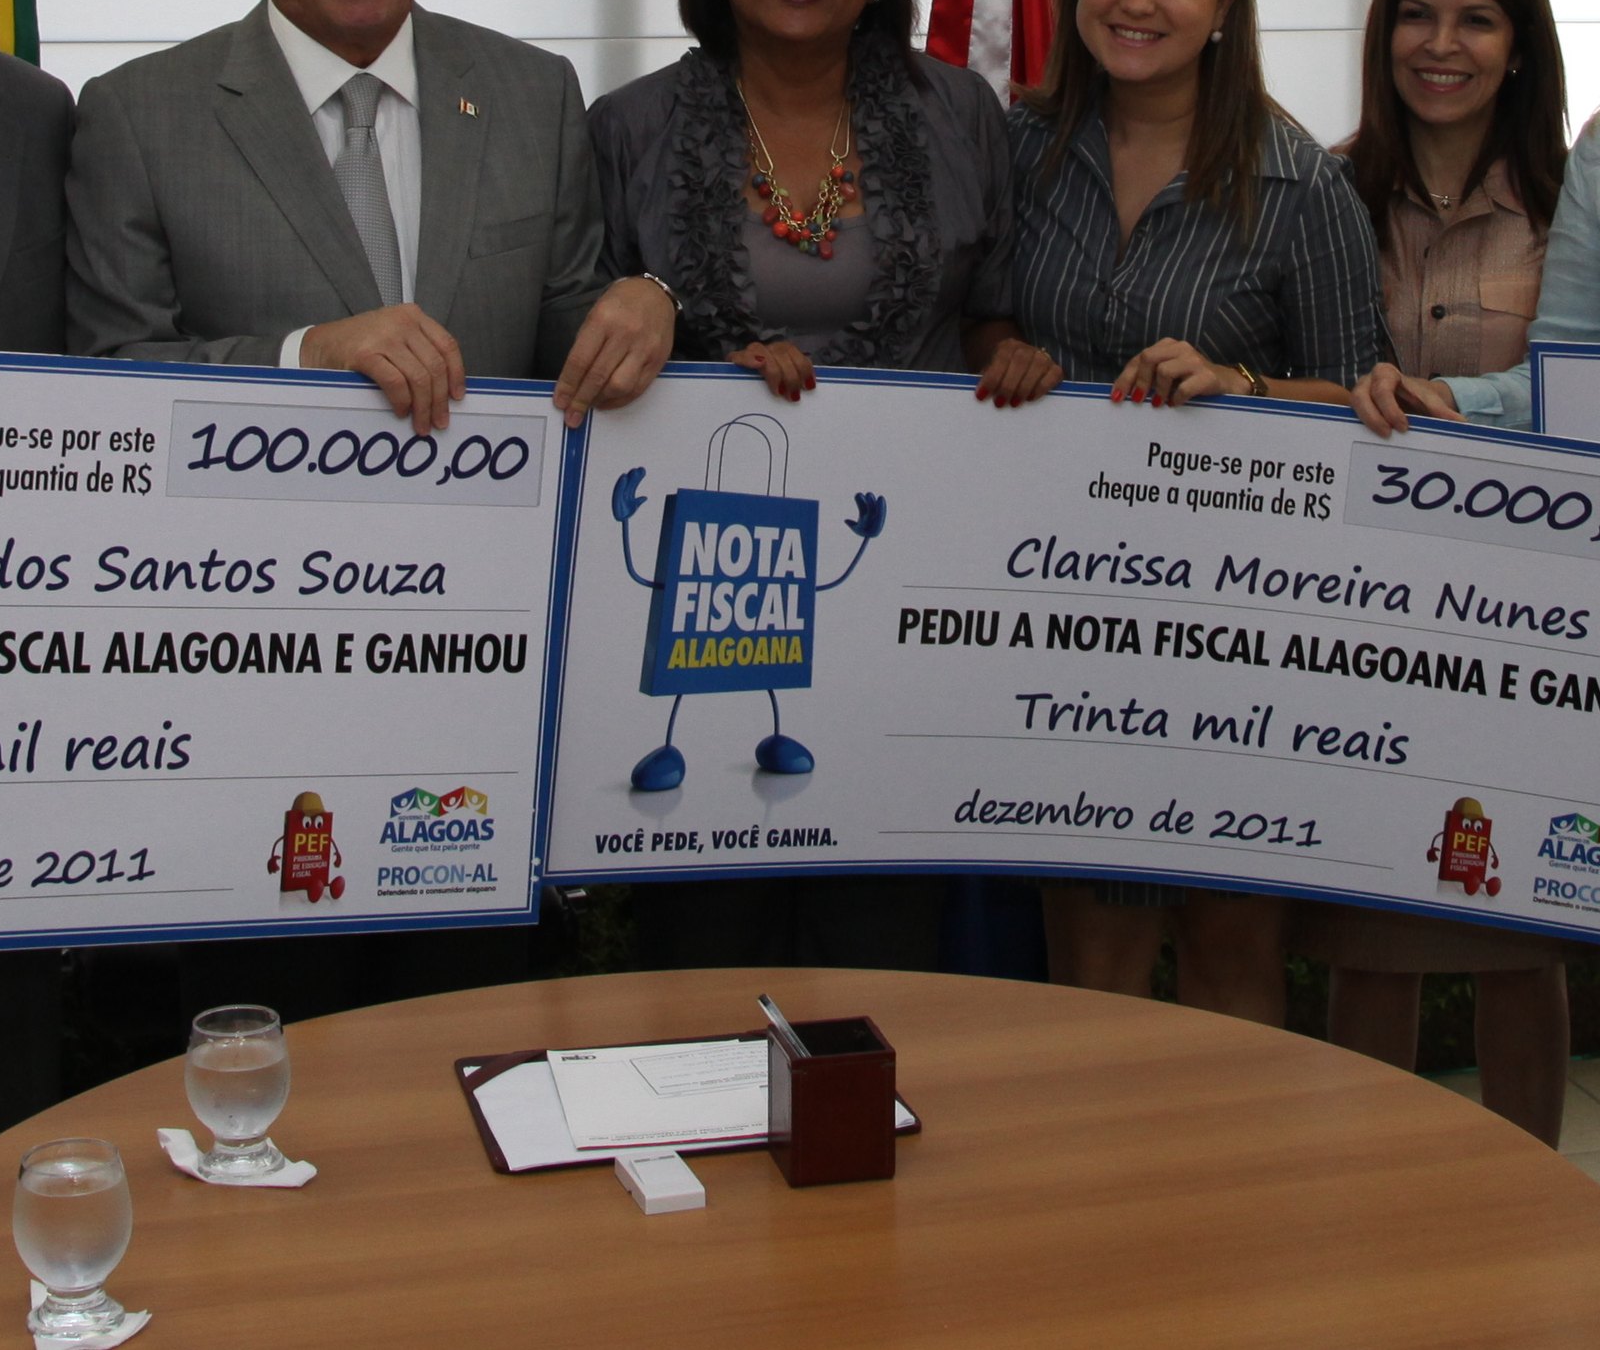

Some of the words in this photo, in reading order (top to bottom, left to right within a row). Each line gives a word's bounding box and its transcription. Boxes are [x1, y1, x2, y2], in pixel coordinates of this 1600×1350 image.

[61, 429, 102, 458] por
[109, 427, 155, 453] este
[187, 418, 530, 486] 100.000,00
[1147, 441, 1243, 477] Pague-se
[1249, 459, 1286, 483] por
[1292, 461, 1335, 485] este
[86, 460, 114, 493] de
[122, 462, 152, 496] R$
[1088, 471, 1160, 508] cheque
[1166, 486, 1180, 505] a
[1186, 487, 1262, 513] quantia
[1270, 487, 1296, 516] de
[1303, 492, 1332, 521] R$
[94, 545, 277, 594] Santos
[298, 550, 446, 597] Souza
[679, 522, 806, 579] NOTA
[672, 581, 804, 633] FISCAL
[1006, 535, 1192, 589] Clarissa
[1214, 554, 1411, 614] Moreira
[1435, 582, 1590, 640] Nunes
[102, 631, 322, 674] ALAGOANA
[335, 633, 355, 674] E
[365, 632, 528, 674] GANHOU
[668, 636, 803, 669] ALAGOANA
[897, 608, 1000, 647] PEDIU
[1008, 612, 1034, 649] A
[1046, 613, 1142, 655] NOTA
[1153, 620, 1270, 667] FISCAL
[1280, 634, 1487, 696] ALAGOANA
[1499, 663, 1520, 701] E
[65, 720, 192, 772] reais
[1015, 690, 1169, 738] Trinta
[1192, 705, 1273, 749] mil
[1292, 721, 1410, 765] reais
[379, 818, 495, 844] ALAGOAS
[595, 827, 645, 854] VOCÊ
[651, 831, 705, 854] PEDE,
[711, 824, 760, 850] VOCÊ
[766, 827, 838, 848] GANHA.
[954, 788, 1134, 830] dezembro
[1149, 798, 1194, 835] de
[1209, 810, 1322, 848] 2011
[295, 833, 328, 853] PEF
[391, 845, 413, 853] Gente
[415, 844, 428, 853] que
[430, 843, 441, 851] faz
[442, 843, 457, 852] pela
[459, 843, 480, 852] gente
[1454, 831, 1487, 852] PEF
[30, 847, 156, 888] 2011
[377, 863, 498, 886] PROCON-AL
[1549, 860, 1570, 869] Gente
[1573, 864, 1586, 872] que
[1588, 866, 1598, 874] faz
